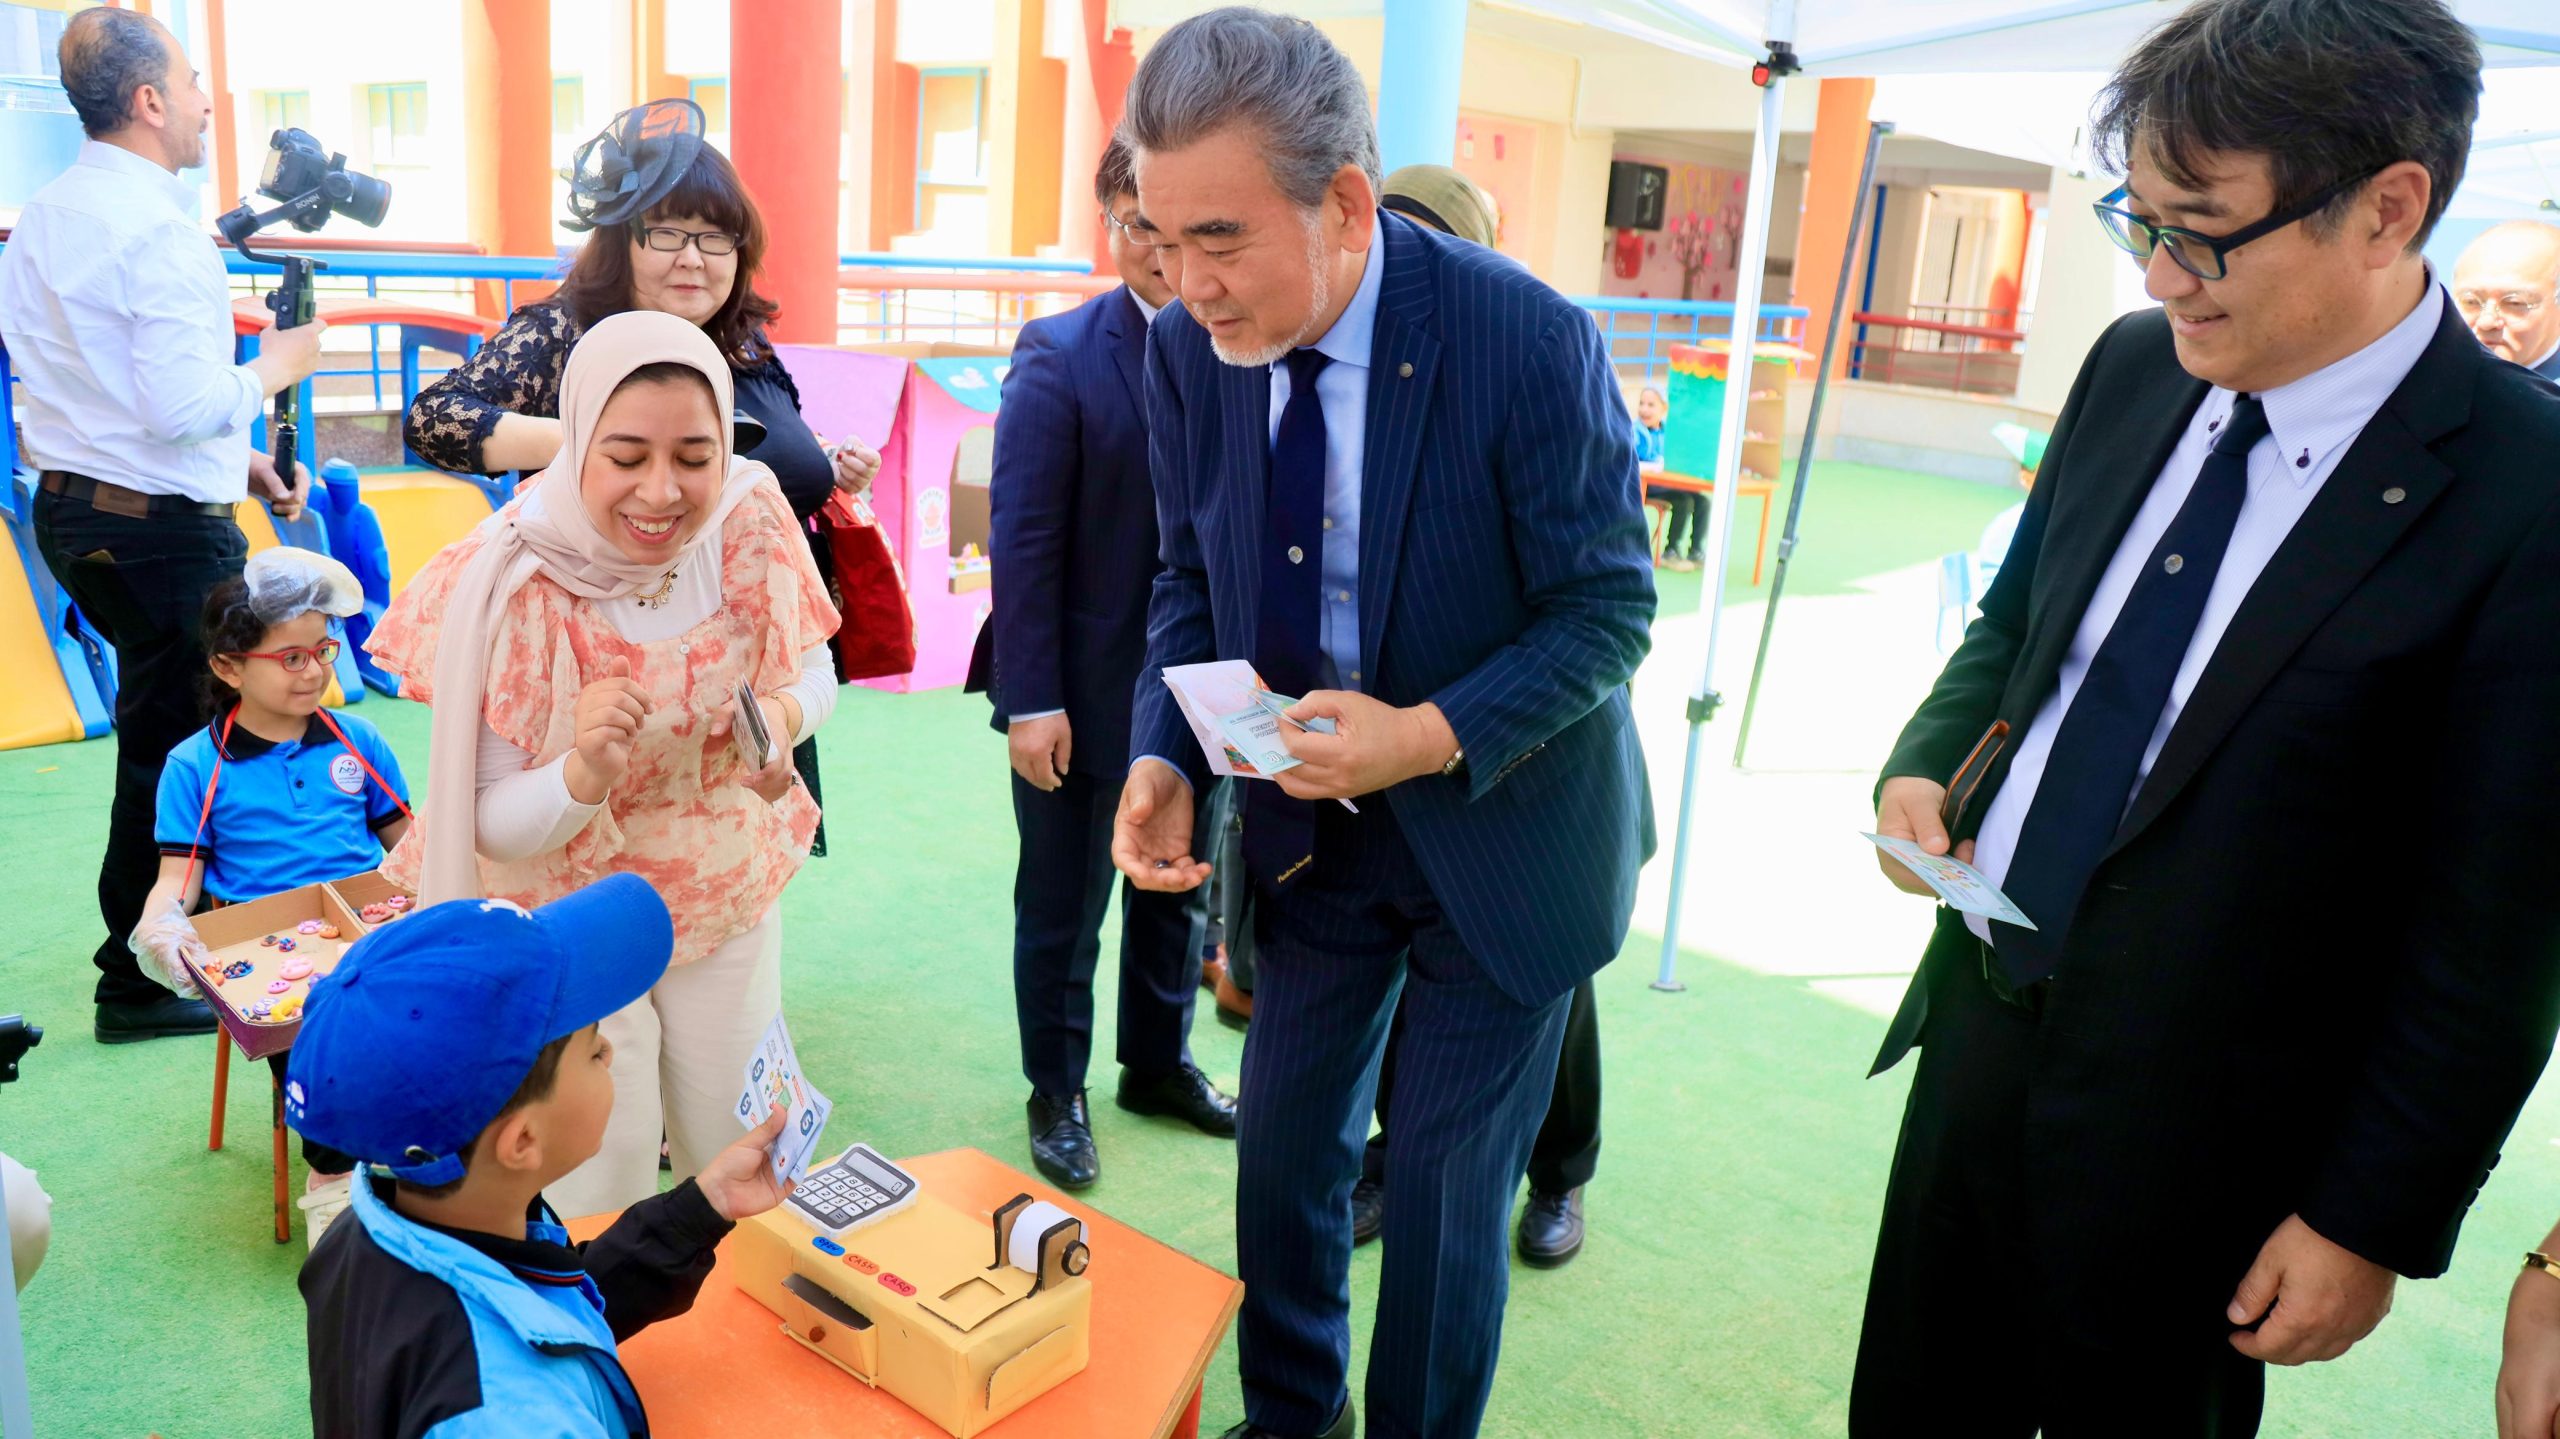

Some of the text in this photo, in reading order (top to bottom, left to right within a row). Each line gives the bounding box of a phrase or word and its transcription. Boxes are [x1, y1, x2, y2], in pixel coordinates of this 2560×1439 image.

[295, 193, 320, 209] RONIN
[848, 1255, 874, 1269] CASH
[883, 1274, 911, 1293] CARD
